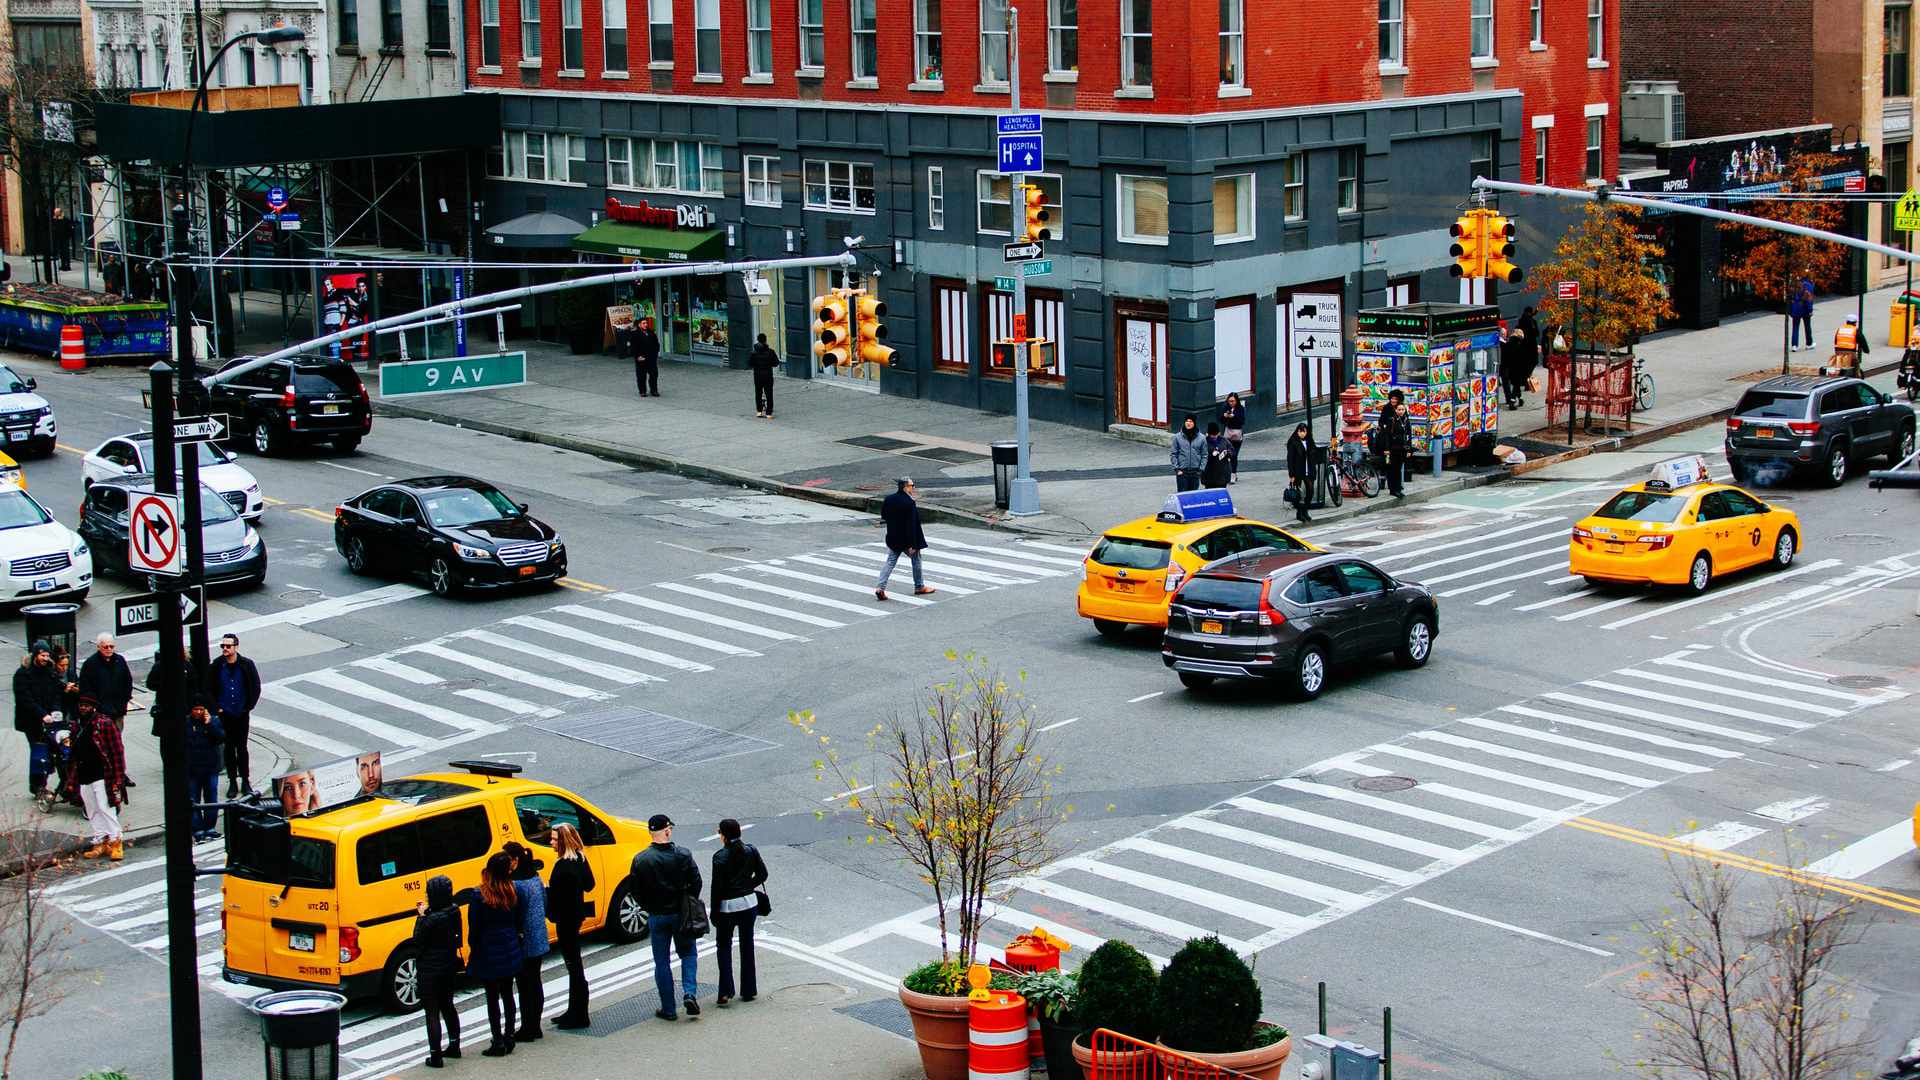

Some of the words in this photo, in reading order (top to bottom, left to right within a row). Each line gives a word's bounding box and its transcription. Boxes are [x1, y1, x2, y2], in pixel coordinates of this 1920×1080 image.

[1003, 142, 1038, 163] HOSPITAL
[1663, 179, 1689, 192] PAPYRUS
[677, 204, 705, 228] Deli
[1009, 249, 1021, 257] ONE
[1026, 246, 1038, 254] WAY
[1024, 262, 1045, 275] HUDSON
[1003, 280, 1009, 289] 14
[1318, 302, 1337, 310] TRUCK
[1318, 315, 1337, 323] ROUTE
[1319, 340, 1338, 348] LOCAL
[425, 367, 440, 387] 9
[450, 365, 484, 385] Av
[198, 423, 218, 434] WAY
[127, 605, 153, 623] ONE
[319, 901, 329, 911] 20
